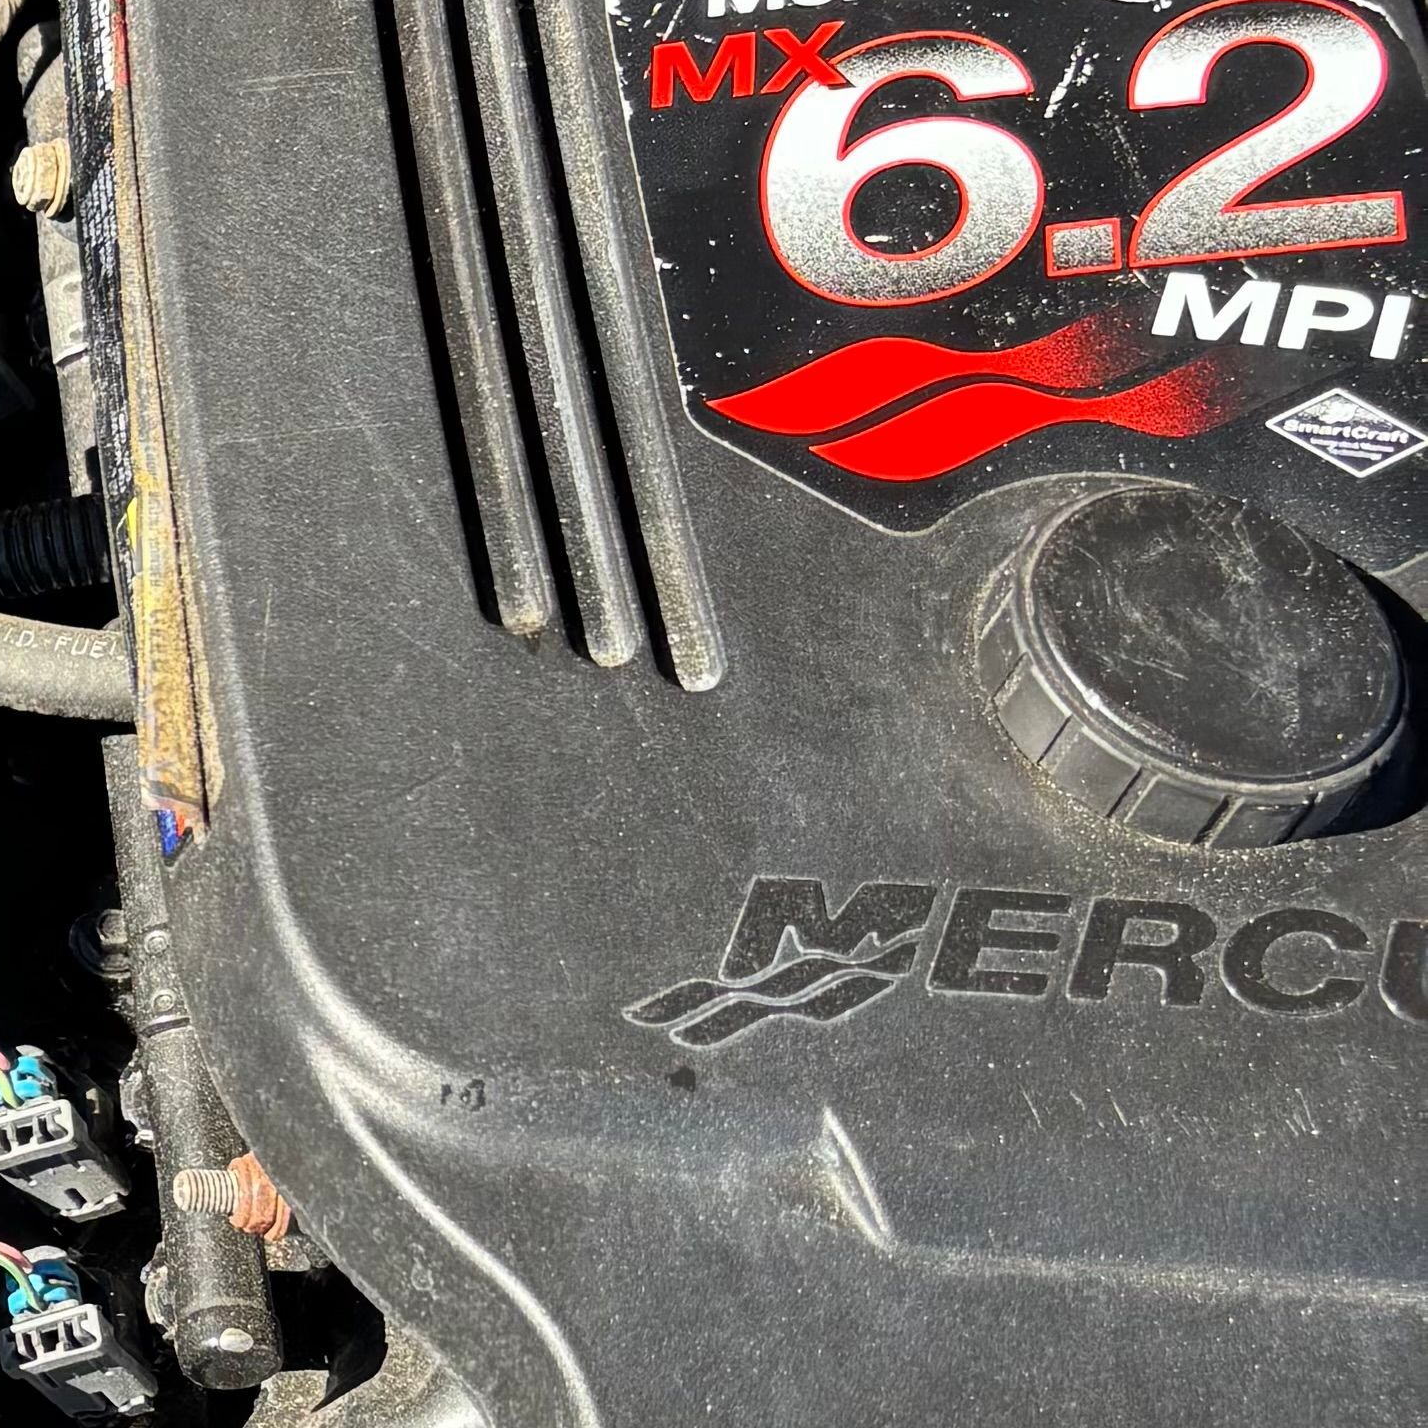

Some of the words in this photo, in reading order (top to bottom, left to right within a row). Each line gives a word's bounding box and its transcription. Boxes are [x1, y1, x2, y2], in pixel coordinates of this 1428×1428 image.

[650, 20, 853, 109] MX
[1149, 271, 1413, 362] MPI
[1282, 418, 1410, 445] SmartCraft
